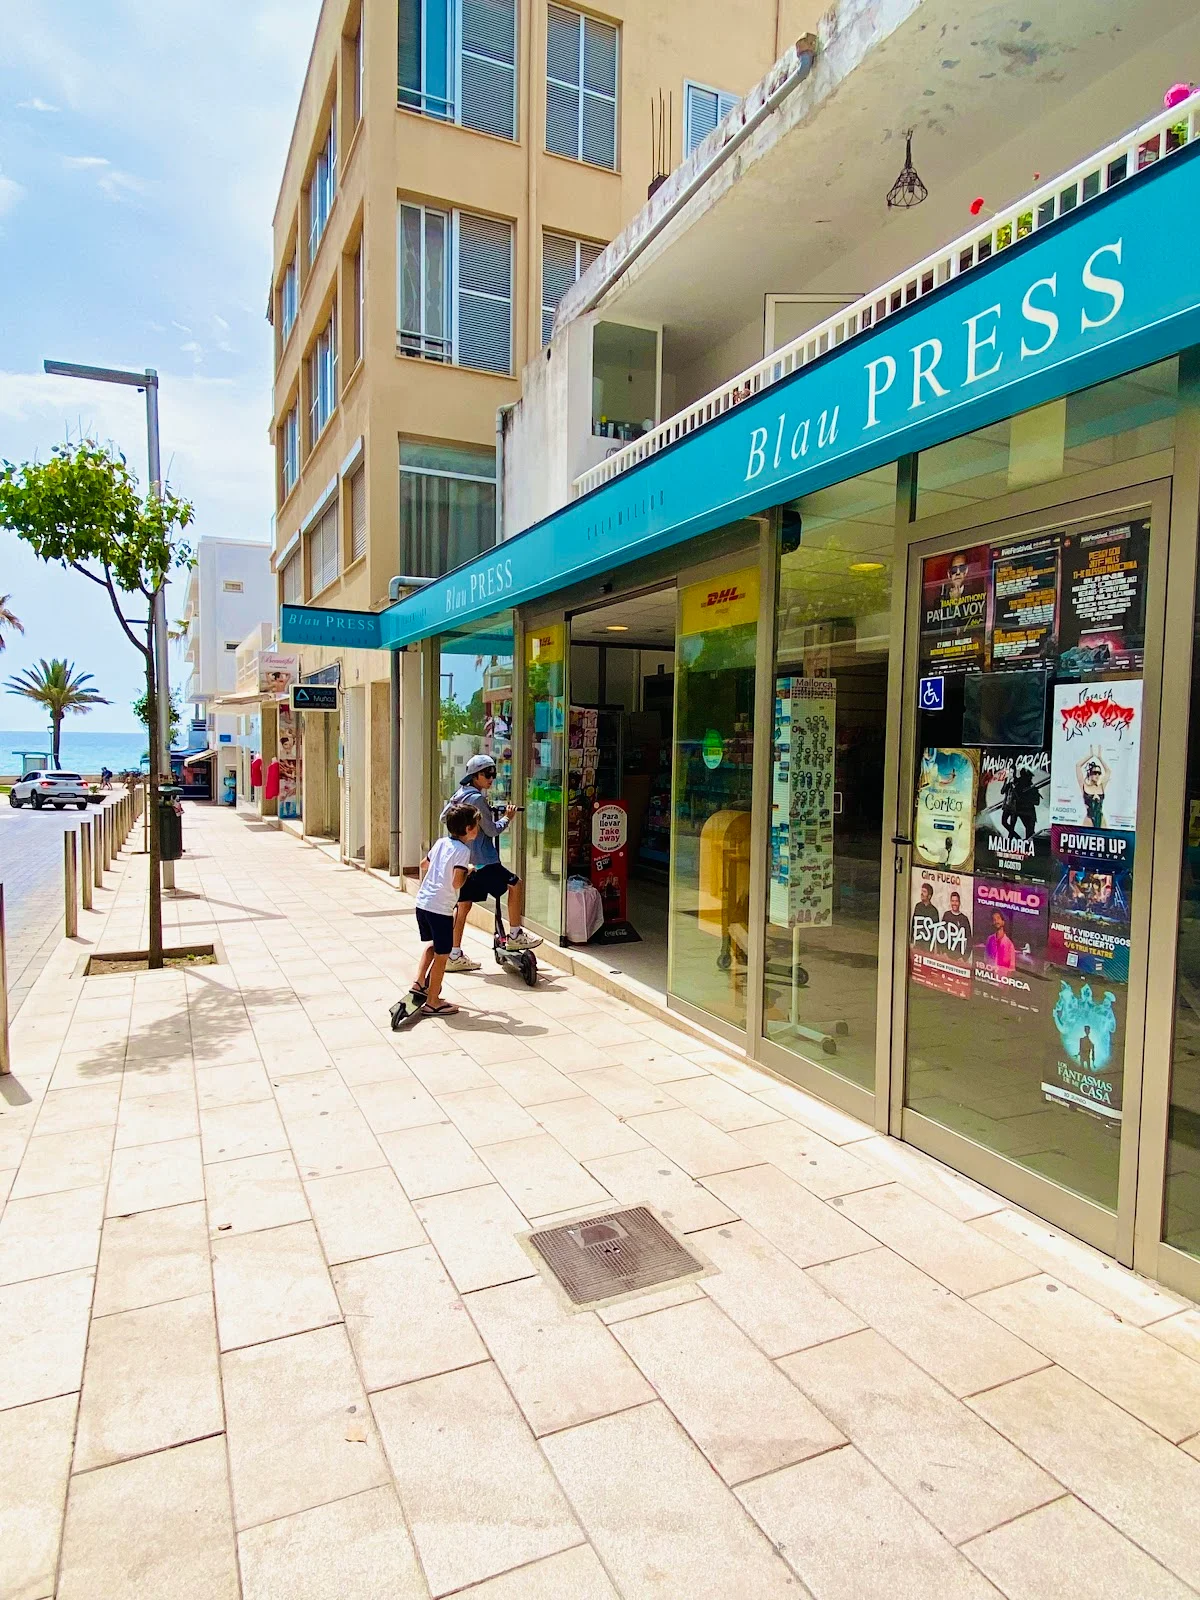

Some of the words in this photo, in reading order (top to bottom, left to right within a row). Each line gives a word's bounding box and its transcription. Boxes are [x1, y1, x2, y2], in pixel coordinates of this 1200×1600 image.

[744, 405, 840, 481] Blau
[862, 236, 1126, 430] PRESS
[445, 588, 467, 613] Blau
[470, 558, 513, 603] PRESS
[706, 587, 739, 606] DHL
[288, 613, 320, 626] Blau
[325, 615, 375, 631] PRESS
[796, 678, 833, 688] Mallorca
[598, 835, 620, 843] away
[599, 828, 620, 836] Take
[1060, 832, 1105, 852] POWER
[1108, 838, 1127, 854] UP
[988, 835, 1035, 857] MALLORCA
[1003, 860, 1022, 871] AGOSTO
[921, 869, 936, 881] Gira
[937, 873, 961, 886] FUEGO
[977, 885, 1041, 908] CAMILO
[977, 898, 995, 906] TOUR
[995, 900, 1020, 912] ESPAÑA
[913, 915, 968, 955] ESTOPA
[1050, 922, 1072, 935] ANIME
[1072, 927, 1078, 935] Y
[1077, 928, 1131, 947] VIDEOJUEGOS
[1063, 932, 1073, 941] EN
[1073, 935, 1115, 951] CONCIERTO
[974, 968, 1031, 992] MALLORCA
[1057, 1065, 1113, 1093] FANTASMAS
[1080, 1082, 1112, 1105] CASA
